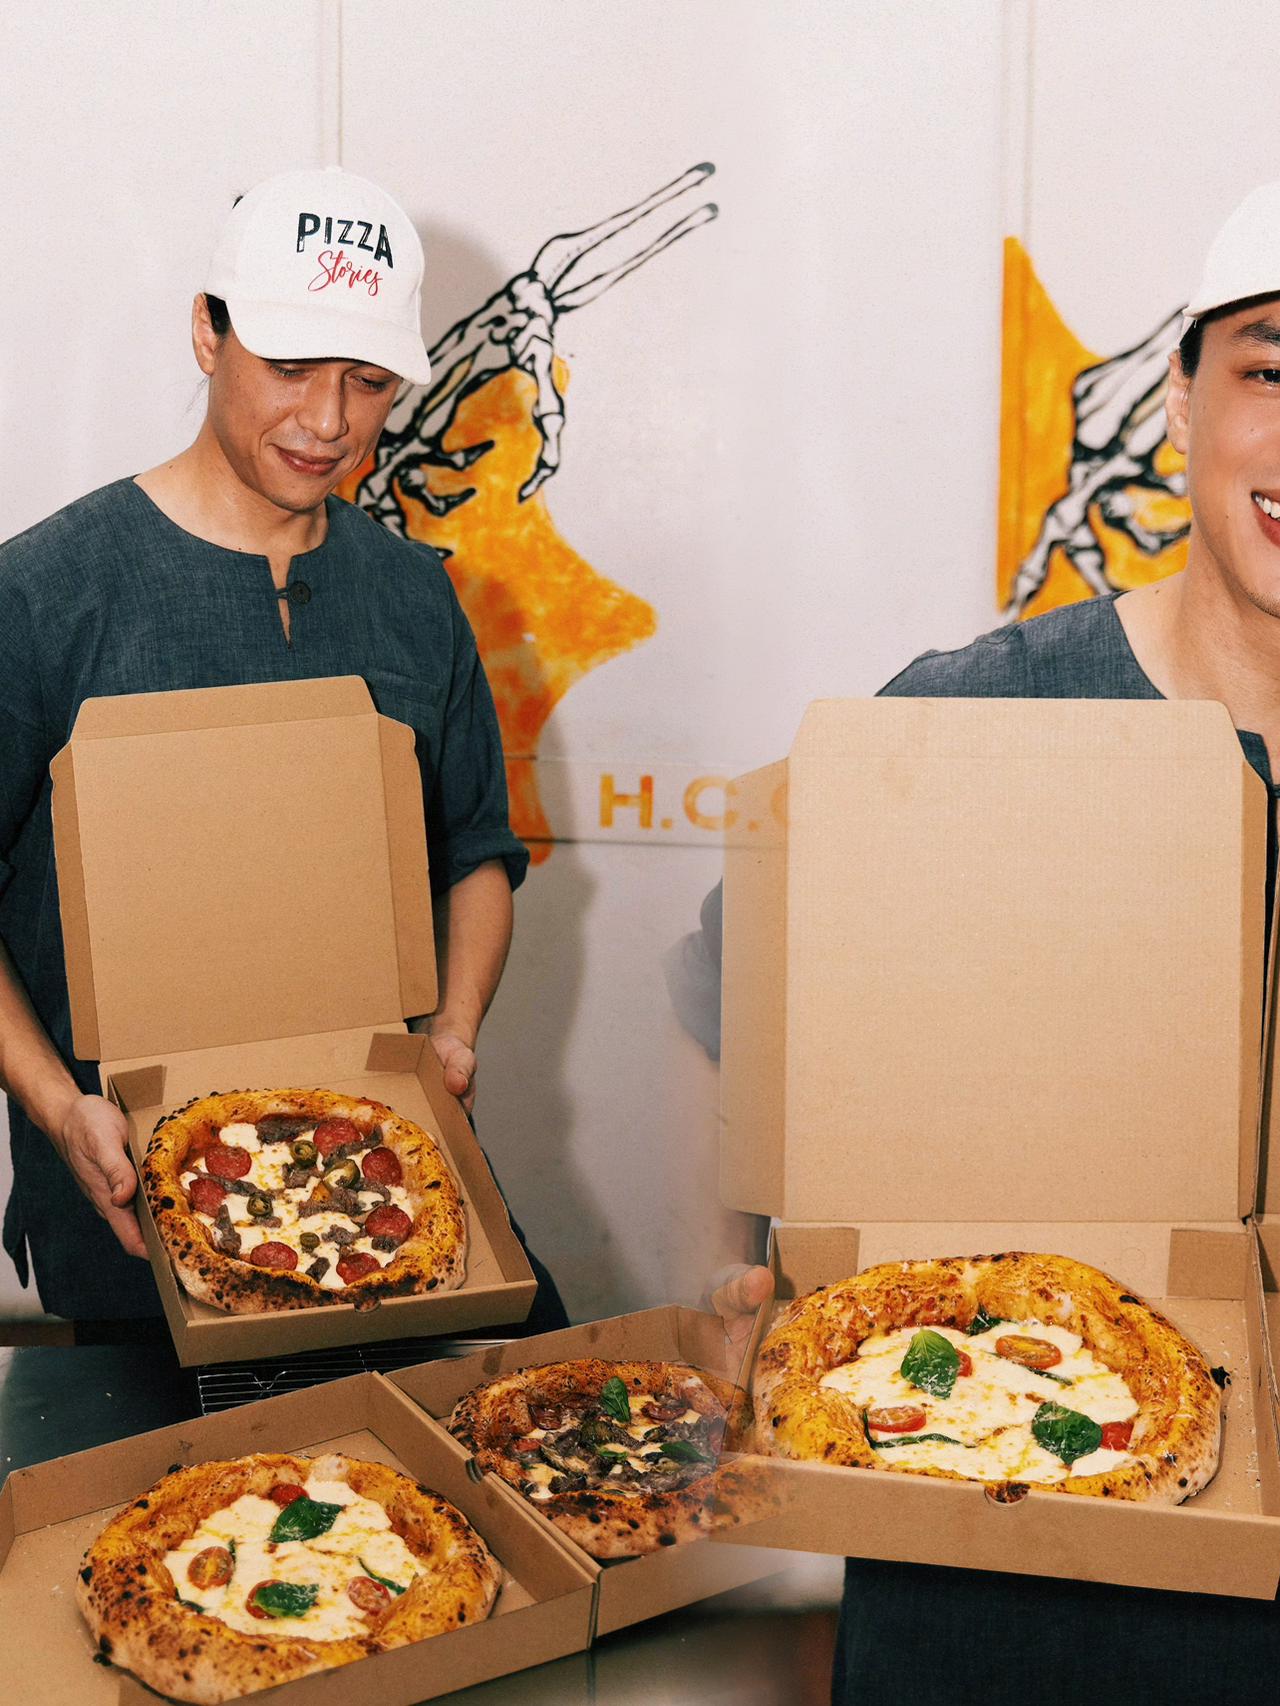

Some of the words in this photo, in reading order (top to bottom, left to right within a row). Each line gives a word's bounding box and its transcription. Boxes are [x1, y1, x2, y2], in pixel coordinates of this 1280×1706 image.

[296, 212, 394, 269] PIZZA
[307, 250, 384, 297] Stories
[599, 774, 789, 832] H.C.
